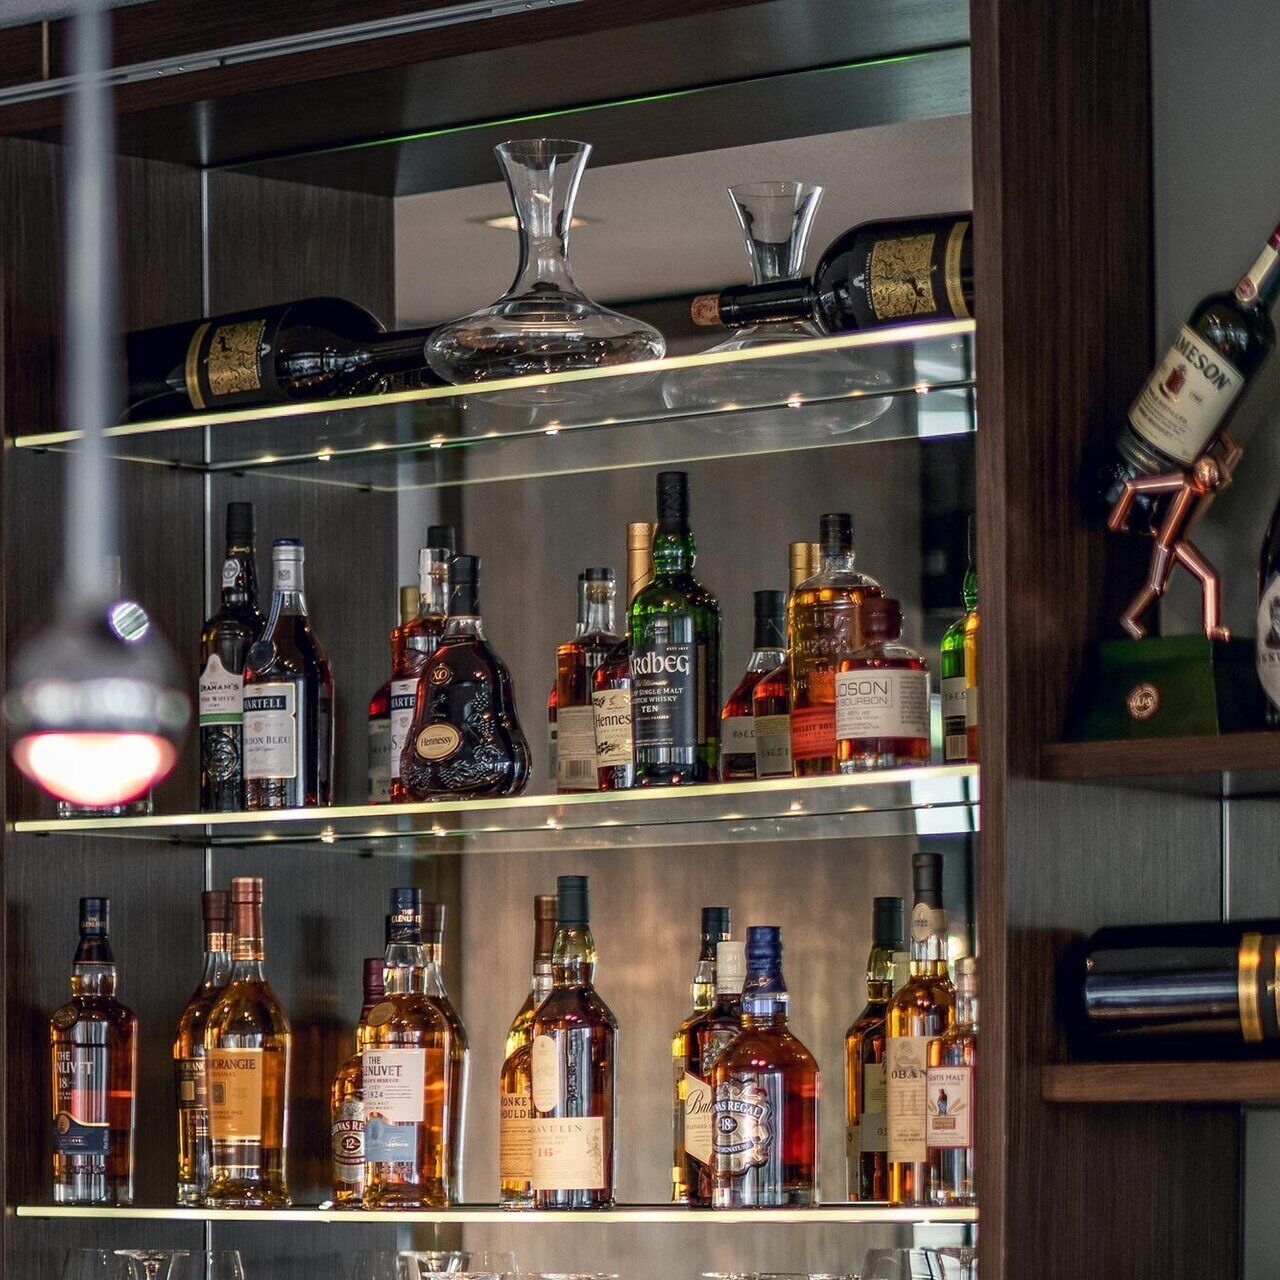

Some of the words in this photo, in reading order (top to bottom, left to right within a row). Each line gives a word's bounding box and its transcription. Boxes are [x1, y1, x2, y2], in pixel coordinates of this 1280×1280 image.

[432, 669, 447, 681] XO
[200, 683, 240, 692] GRAHAM'S
[663, 687, 683, 695] MALT
[841, 697, 888, 707] BOURBON
[641, 705, 659, 713] TEN
[420, 735, 452, 747] Hennessy
[58, 1051, 70, 1061] THE
[369, 1056, 381, 1064] THE
[891, 1069, 927, 1079] OBAN
[728, 1101, 760, 1118] REGAL
[721, 1118, 731, 1131] 18
[345, 1138, 355, 1149] 12
